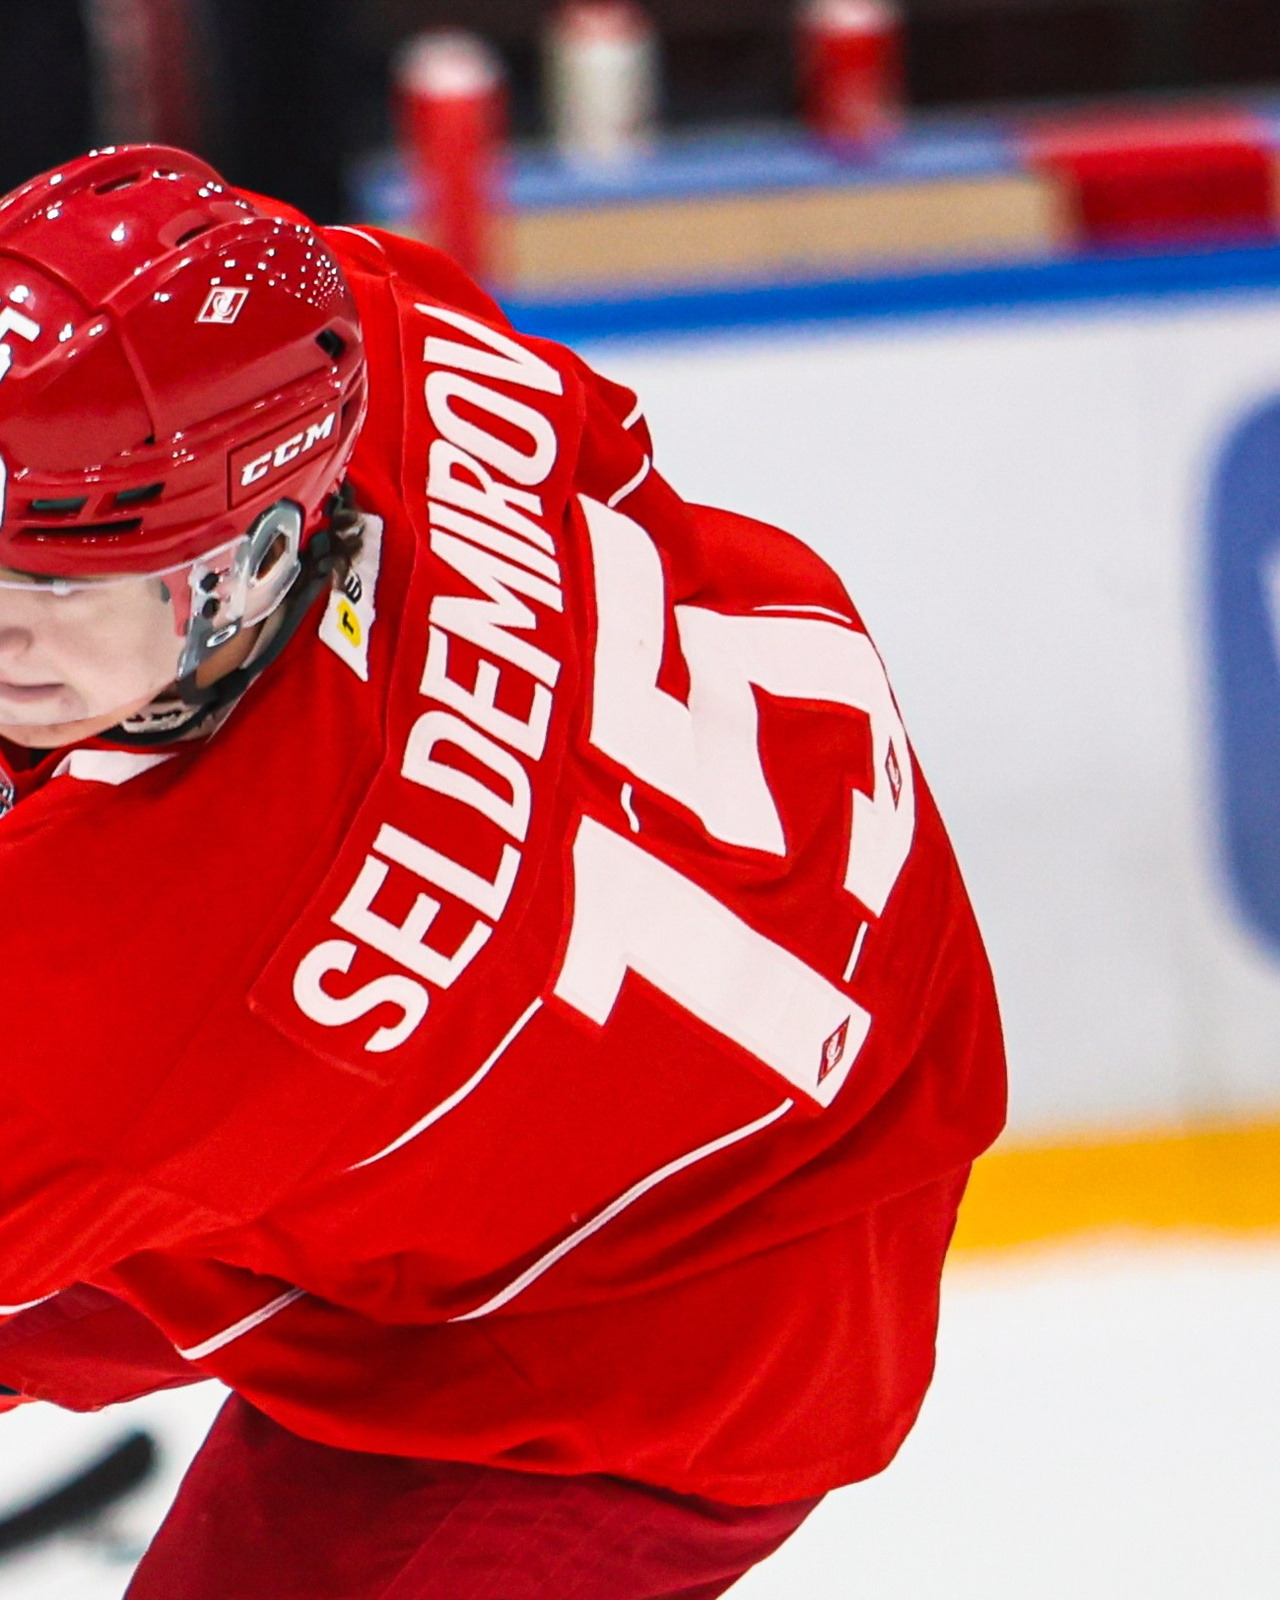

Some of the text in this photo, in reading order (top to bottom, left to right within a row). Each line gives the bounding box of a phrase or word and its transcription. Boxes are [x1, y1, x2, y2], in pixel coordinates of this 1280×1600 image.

[240, 411, 336, 487] CCM
[292, 302, 565, 1054] SELDEMIROV
[552, 493, 917, 1110] 15
